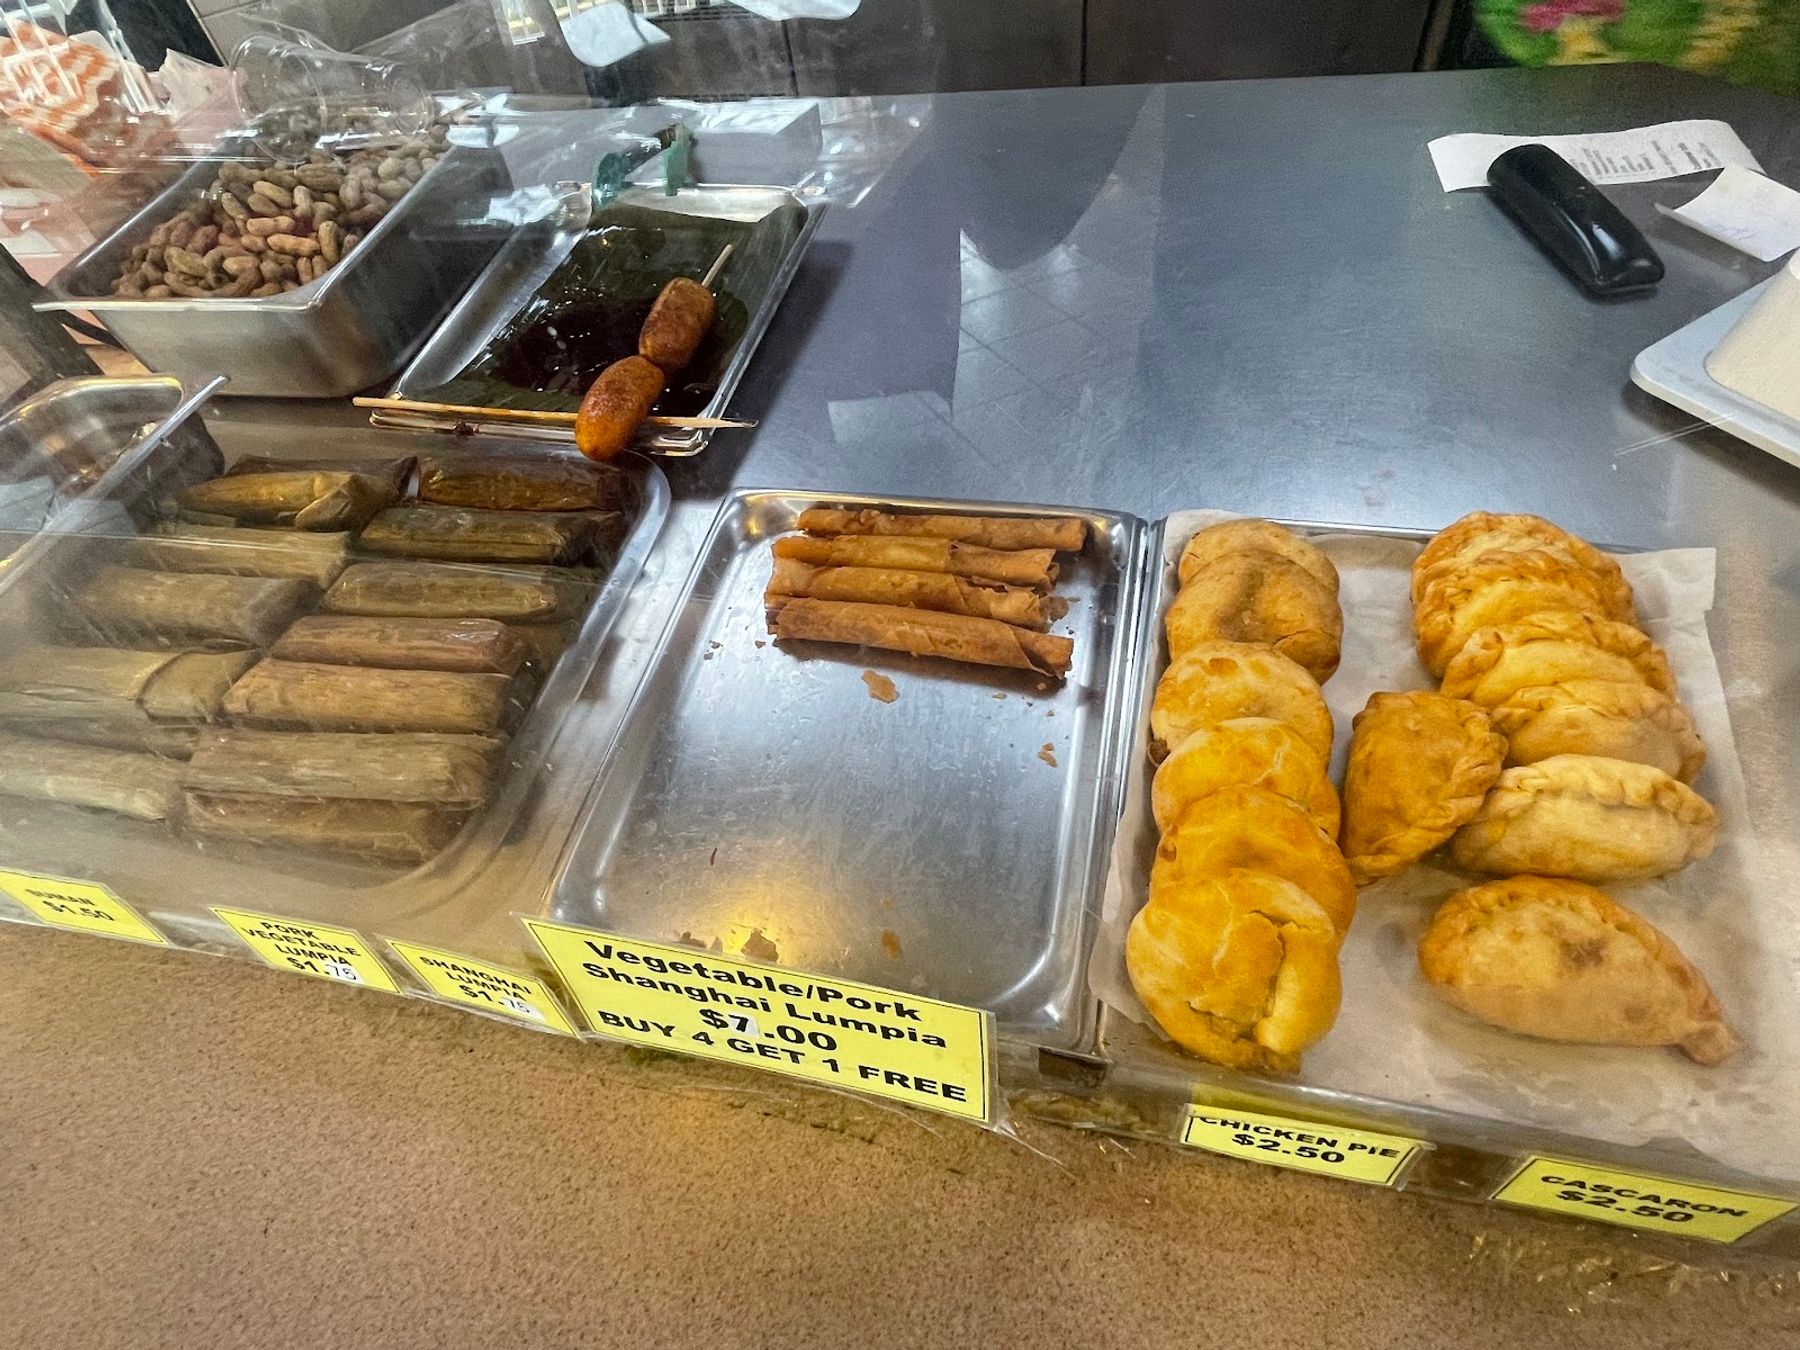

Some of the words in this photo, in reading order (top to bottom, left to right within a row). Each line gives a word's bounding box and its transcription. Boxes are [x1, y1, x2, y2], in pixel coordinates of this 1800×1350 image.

[242, 928, 361, 957] VEGETABLE
[261, 921, 320, 940] PORK
[275, 944, 353, 966] LUMPIA
[419, 956, 532, 995] SHANGHAI
[446, 971, 526, 1001] LUMPIA
[583, 940, 922, 1022] Vegetable/Pork
[582, 962, 771, 1013] Shanghai
[785, 1003, 947, 1048] Lumpia
[699, 1008, 838, 1051] $7.00
[598, 1011, 675, 1038] BUY
[692, 1031, 715, 1046] 4
[727, 1038, 806, 1065] GET
[822, 1058, 841, 1073] 1
[858, 1065, 967, 1103] FREE
[1200, 1116, 1339, 1148] CHICKEN
[1348, 1142, 1401, 1159] PIE
[1232, 1133, 1346, 1164] $2.50
[1541, 1175, 1749, 1217] CASCARON
[1556, 1190, 1694, 1223] $2.50
